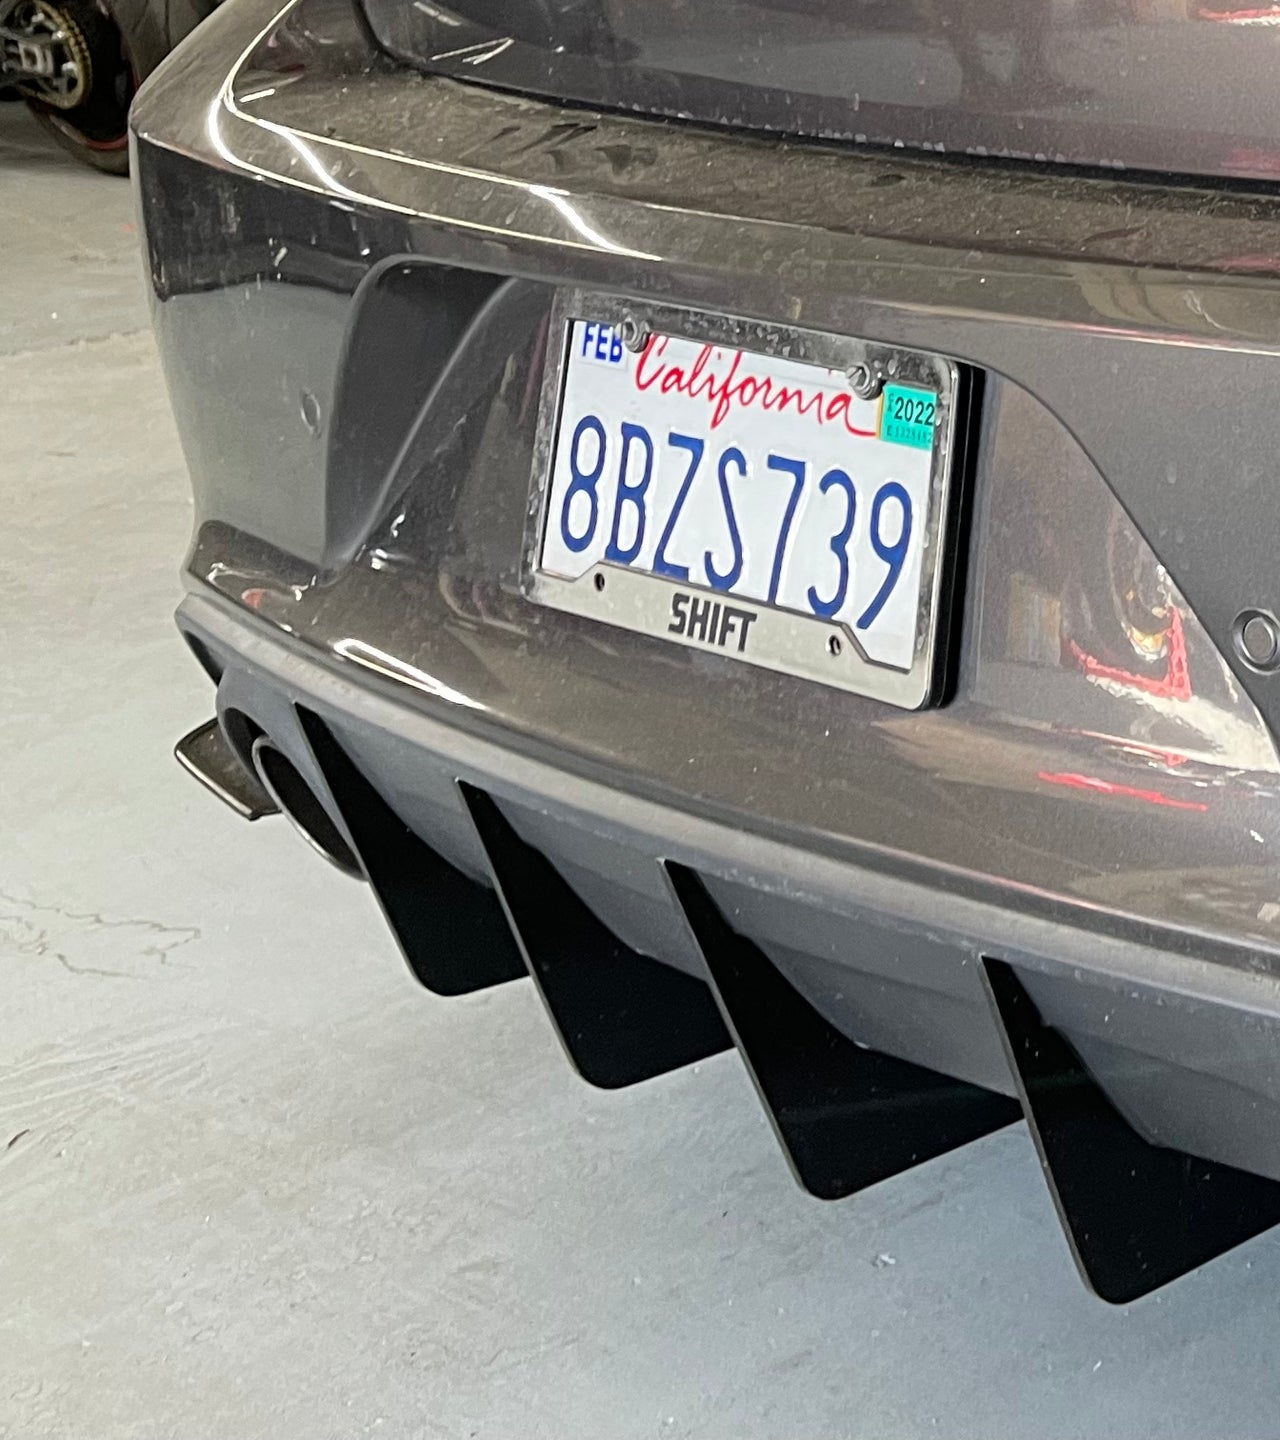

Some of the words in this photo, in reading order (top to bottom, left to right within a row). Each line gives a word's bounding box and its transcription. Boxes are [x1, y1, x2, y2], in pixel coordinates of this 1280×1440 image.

[635, 332, 878, 436] California
[894, 396, 935, 427] 2022
[560, 415, 913, 630] 8BZS739
[667, 593, 757, 653] SHIFT
